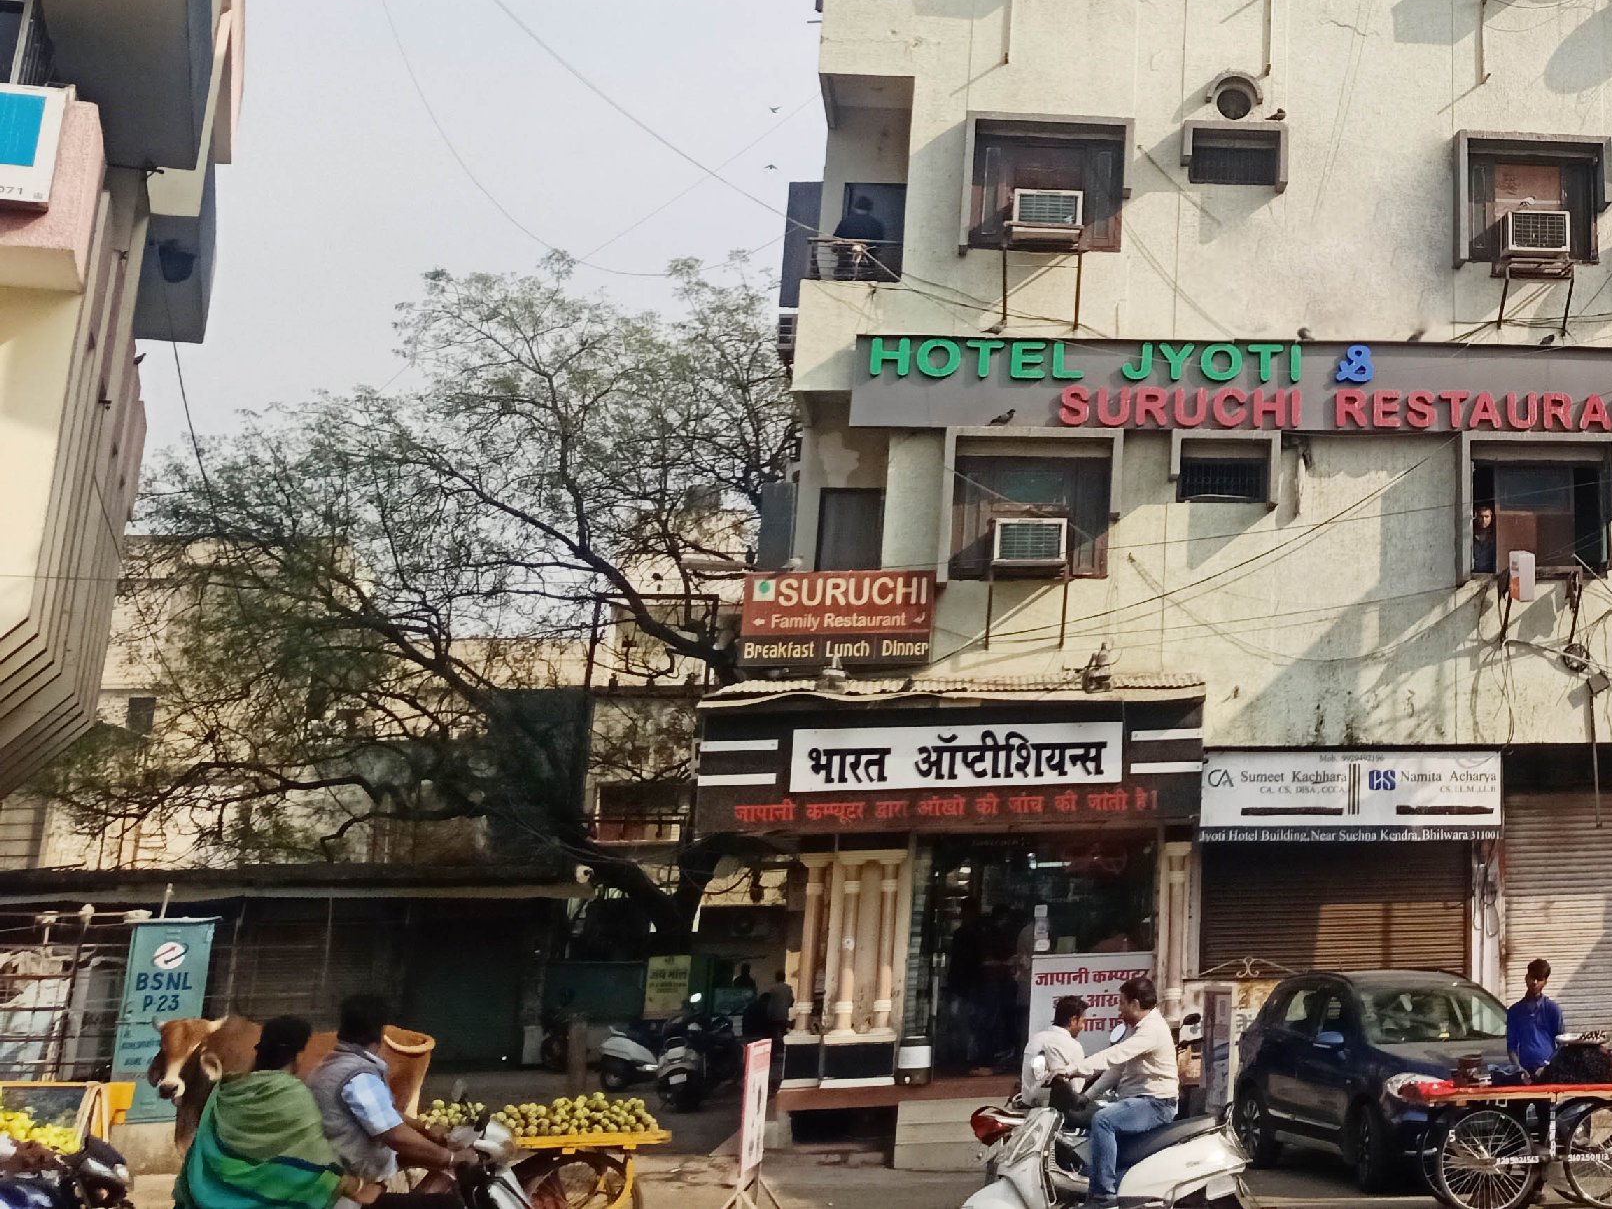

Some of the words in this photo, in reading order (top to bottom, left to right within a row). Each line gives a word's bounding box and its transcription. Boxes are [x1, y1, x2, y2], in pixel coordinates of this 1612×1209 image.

[868, 338, 1084, 382] HOTEL
[1121, 342, 1302, 383] JYOTI
[1336, 345, 1374, 383] &
[1057, 384, 1302, 428] SURUCHI
[778, 576, 928, 607] SURUCHI
[771, 613, 820, 631] Family
[823, 611, 906, 628] Restaurant
[743, 641, 815, 659] Breakfast
[825, 640, 870, 659] Lunch
[881, 640, 929, 657] Dinner
[807, 744, 891, 784] भारत
[915, 729, 1108, 782] ऑप्टीशियन्स
[1240, 770, 1285, 783] Sumeet
[1400, 770, 1442, 782] Namita
[1449, 770, 1497, 783] Acharya
[734, 798, 796, 822] जापानी
[974, 792, 1000, 816] की
[1054, 790, 1078, 812] की
[1199, 830, 1226, 842] Jyoti
[1228, 829, 1258, 842] Hotel
[1311, 829, 1336, 842] Near
[1338, 829, 1377, 842] Suchna
[1423, 828, 1469, 841] Bhilwara
[135, 972, 193, 991] BSNL
[1034, 967, 1090, 986] जापानी
